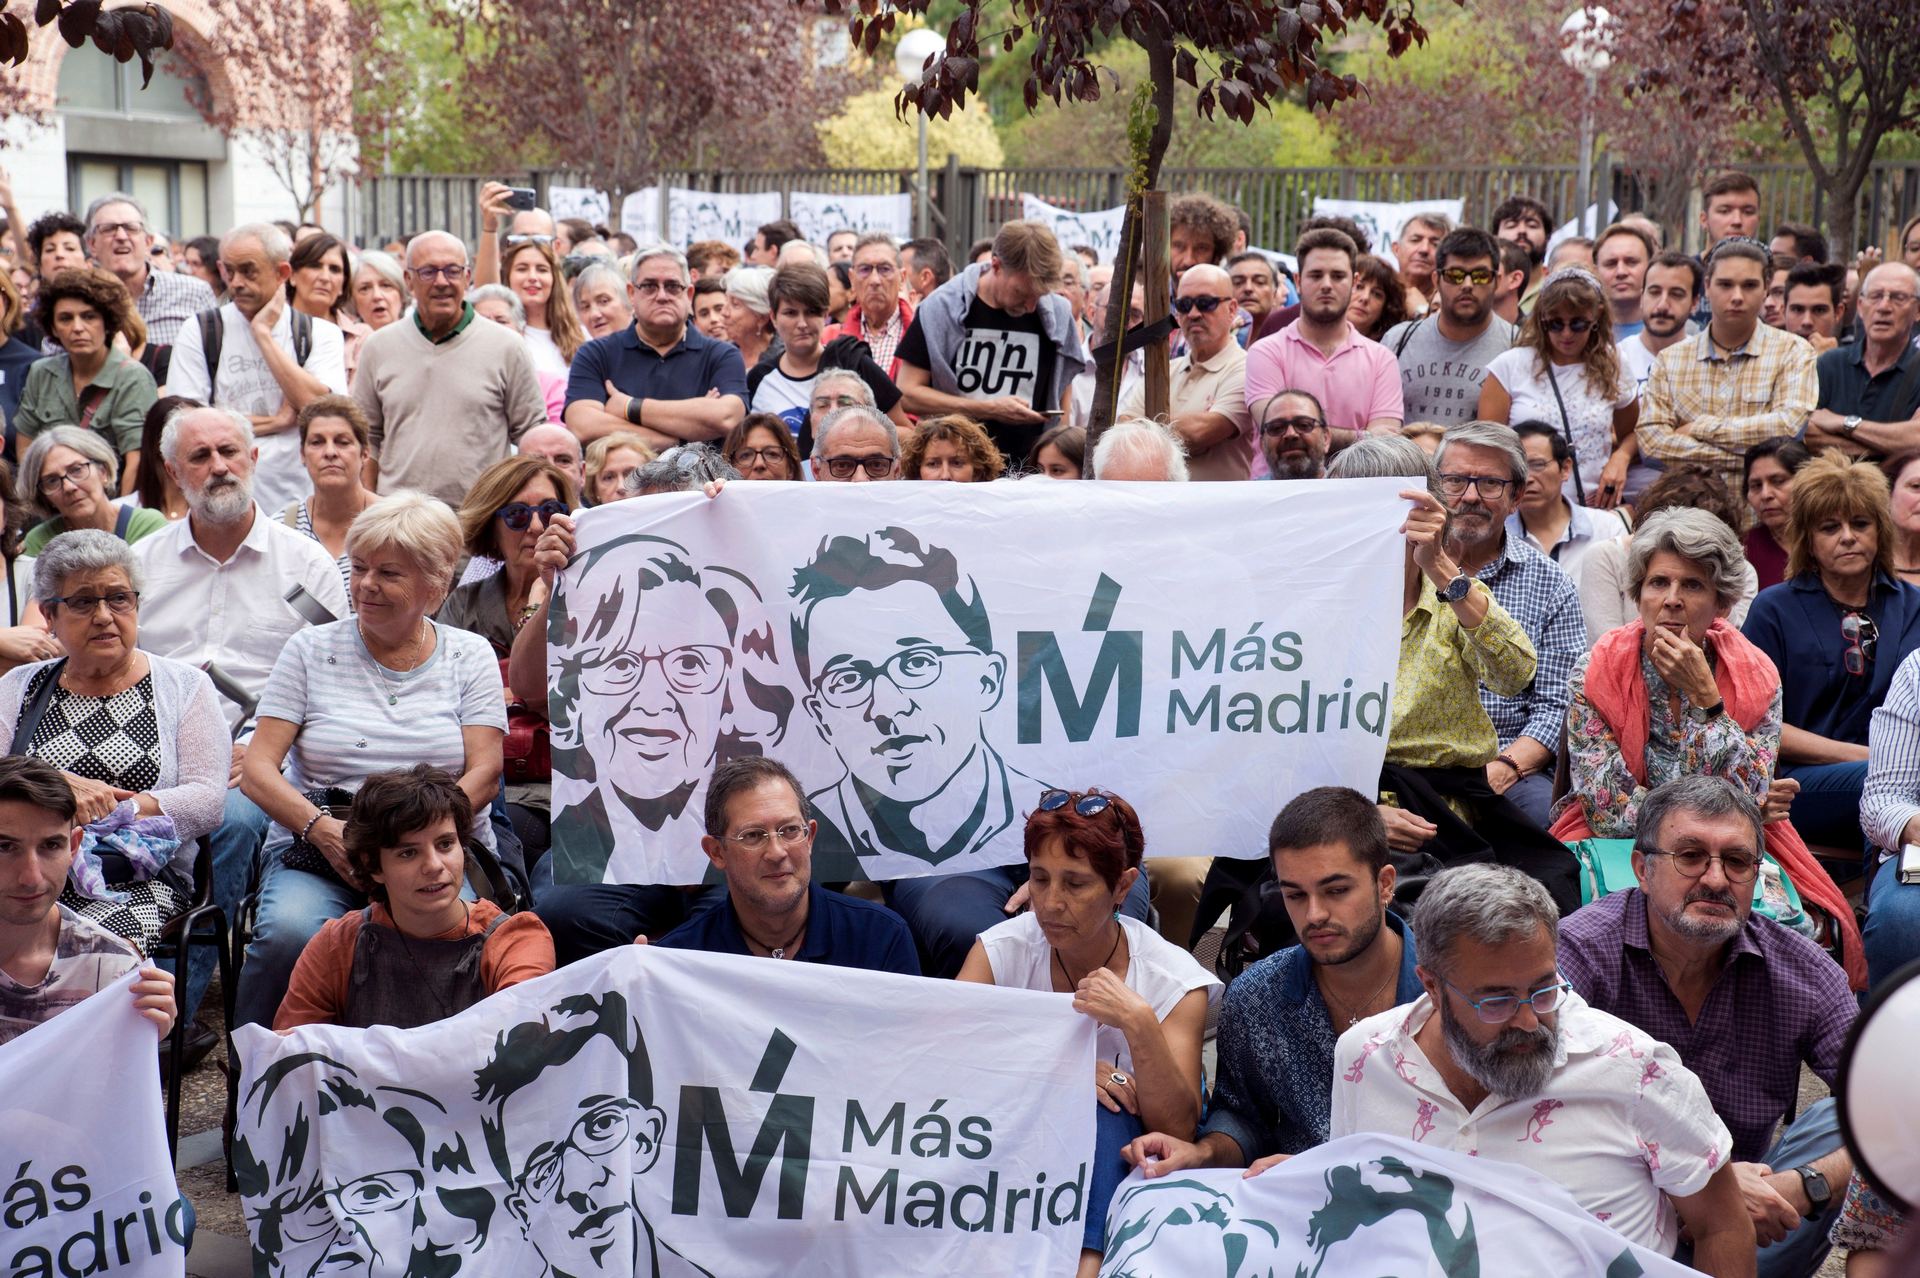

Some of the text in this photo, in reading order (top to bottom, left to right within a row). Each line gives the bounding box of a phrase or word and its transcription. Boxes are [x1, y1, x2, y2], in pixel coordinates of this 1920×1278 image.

[1403, 361, 1486, 388] TOCKHO
[1424, 385, 1465, 399] 1986
[1171, 621, 1303, 679] Más
[1166, 678, 1389, 737] Madrid
[842, 1098, 993, 1160] Más
[3, 1160, 91, 1229] ás
[834, 1162, 1087, 1234] Madrid
[9, 1190, 185, 1278] adri
